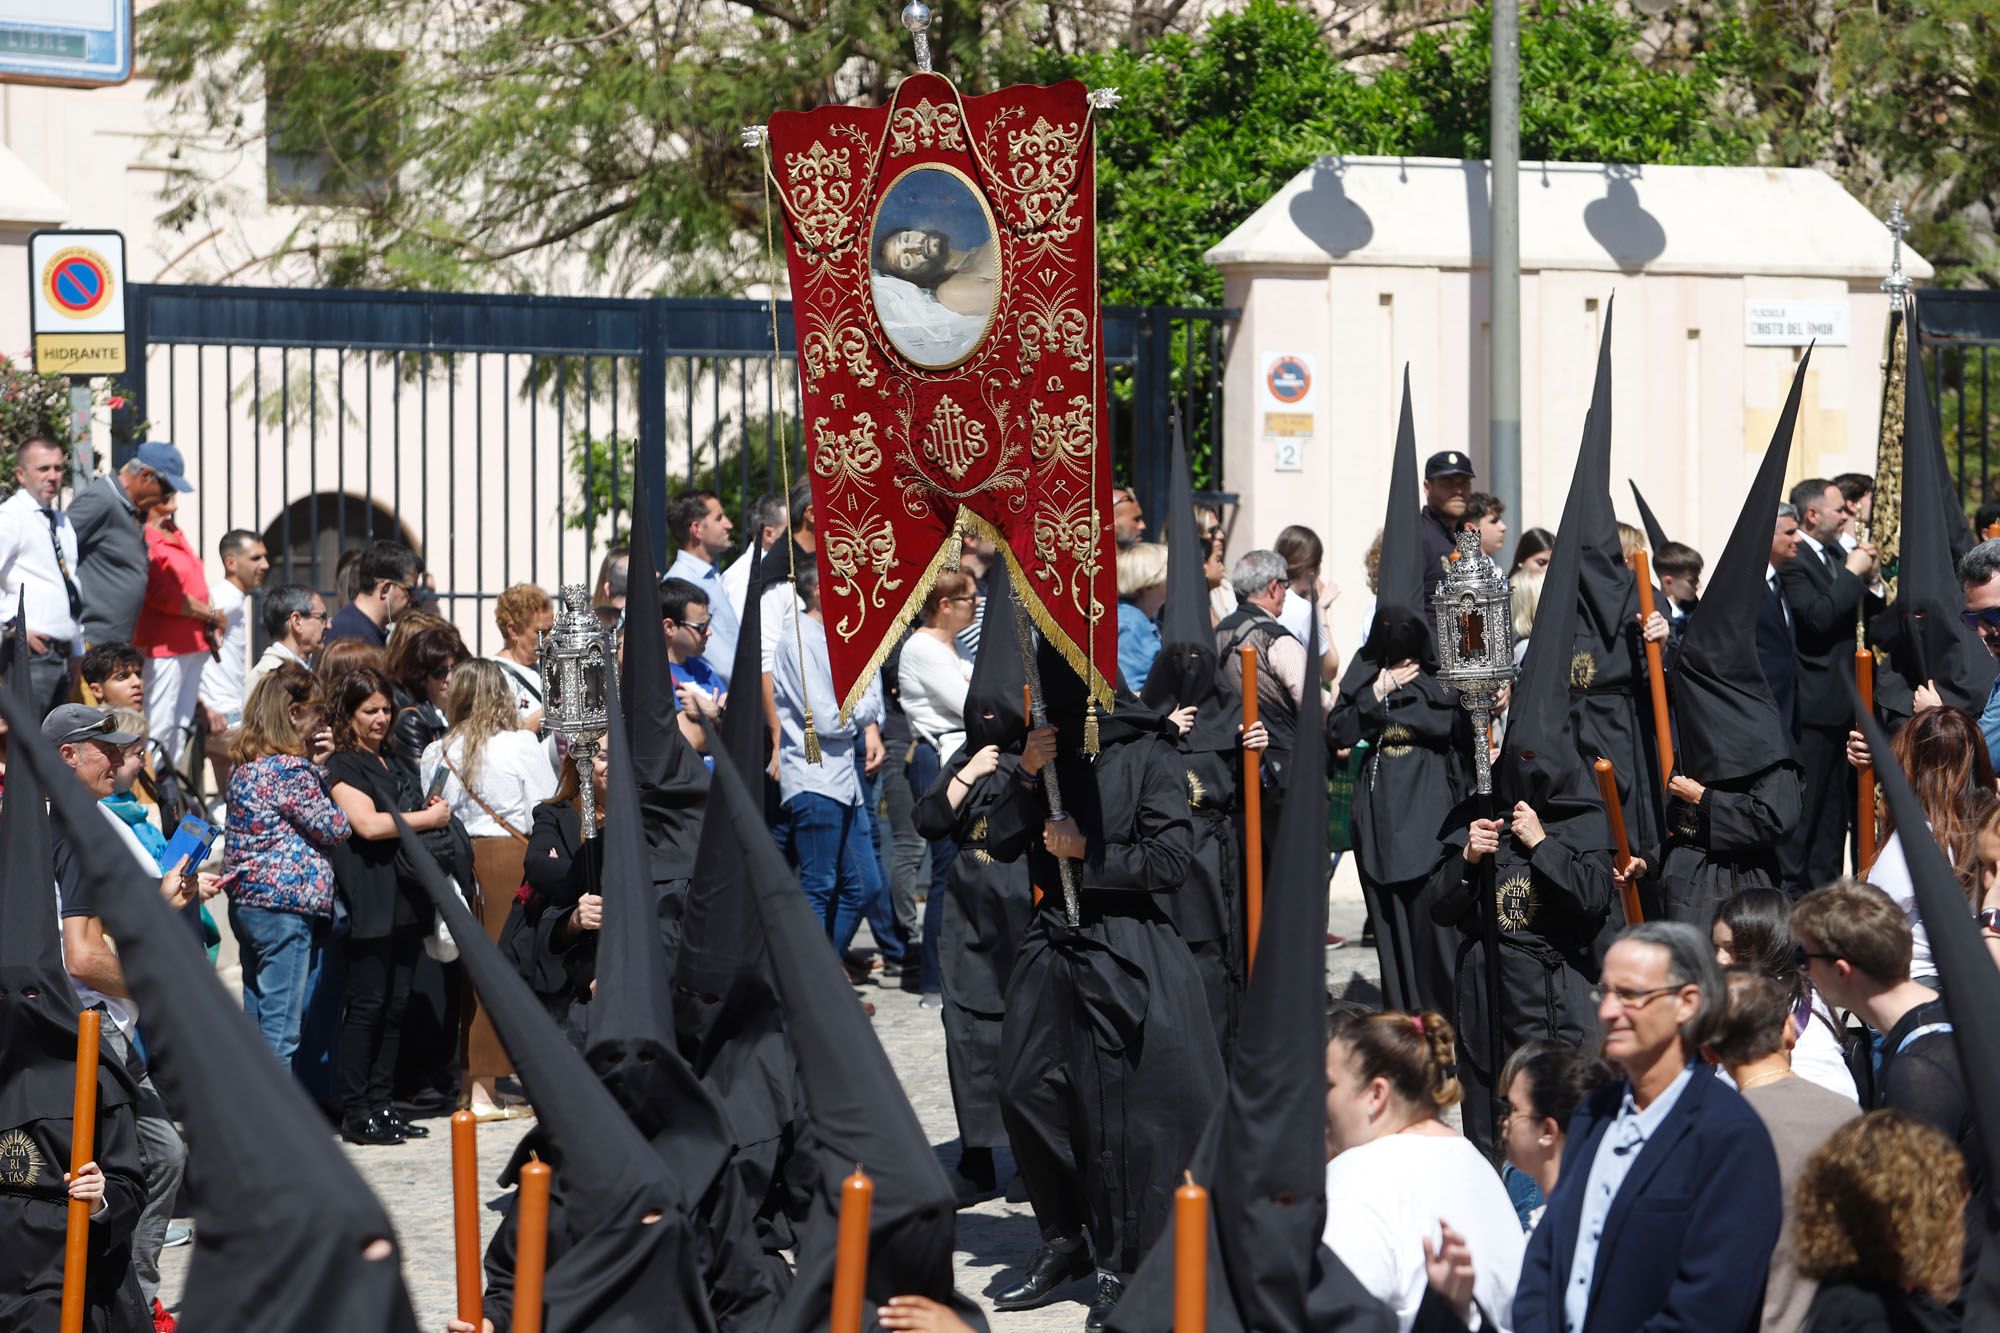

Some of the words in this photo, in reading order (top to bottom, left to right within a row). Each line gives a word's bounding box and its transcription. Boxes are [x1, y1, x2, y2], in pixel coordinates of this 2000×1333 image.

[1751, 322, 1783, 335] CRISTO
[1787, 322, 1803, 335] DEL
[1806, 321, 1833, 335] AMOR
[44, 347, 119, 360] HIDRANTE
[1283, 445, 1296, 465] 2
[1506, 887, 1525, 898] CHA
[1511, 898, 1520, 908] RI
[1507, 909, 1524, 920] TAS
[4, 1145, 26, 1157] CHA
[10, 1159, 20, 1170] RI
[5, 1171, 25, 1183] TAS
